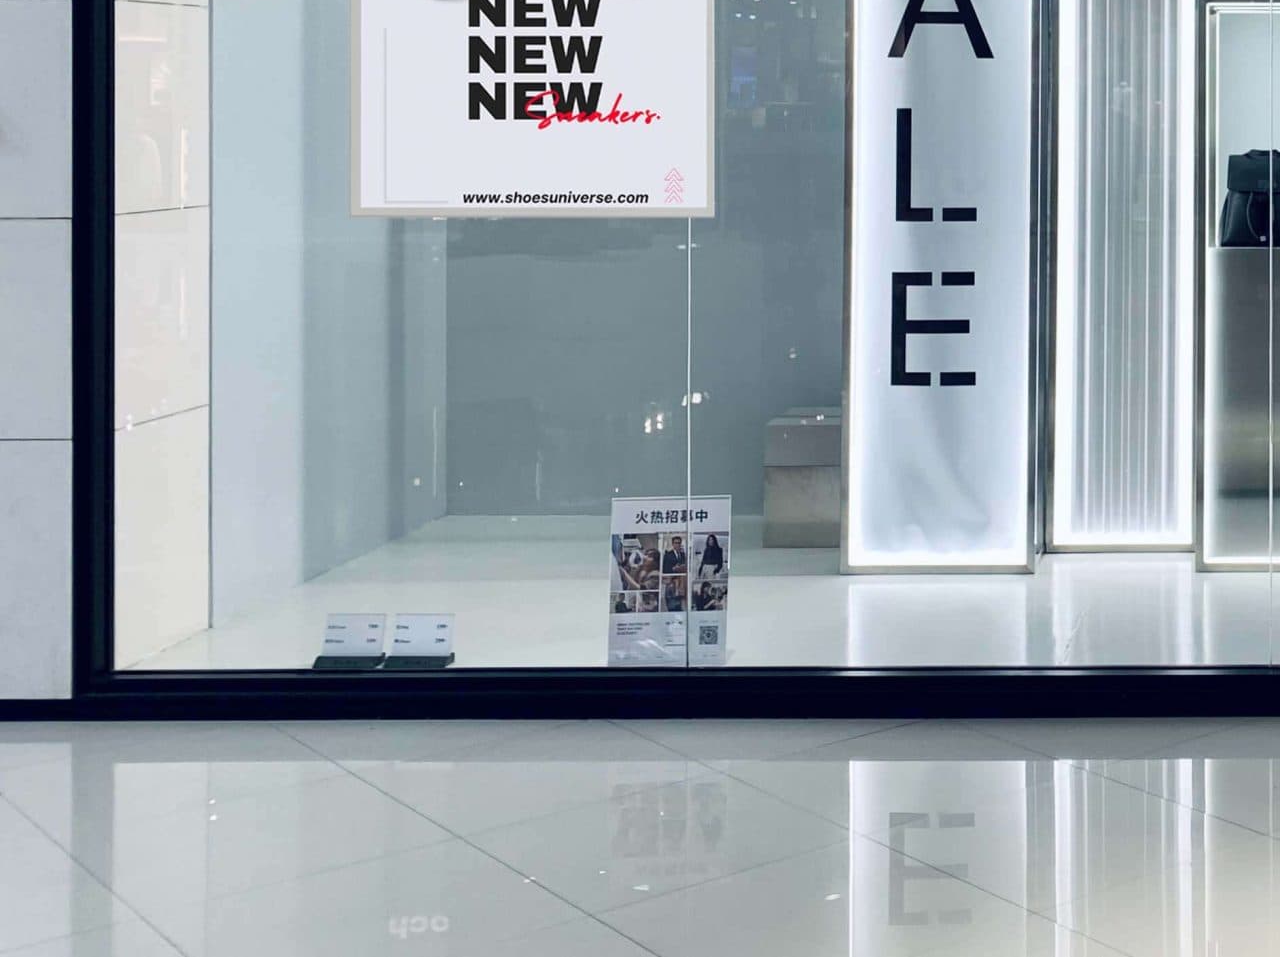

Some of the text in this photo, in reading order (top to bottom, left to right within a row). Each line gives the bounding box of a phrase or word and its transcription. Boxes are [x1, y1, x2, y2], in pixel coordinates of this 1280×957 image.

[468, 35, 603, 74] NEW
[468, 82, 603, 120] NEW
[463, 191, 649, 205] www.shoesuniverse.com
[634, 509, 709, 524] 火热招募中
